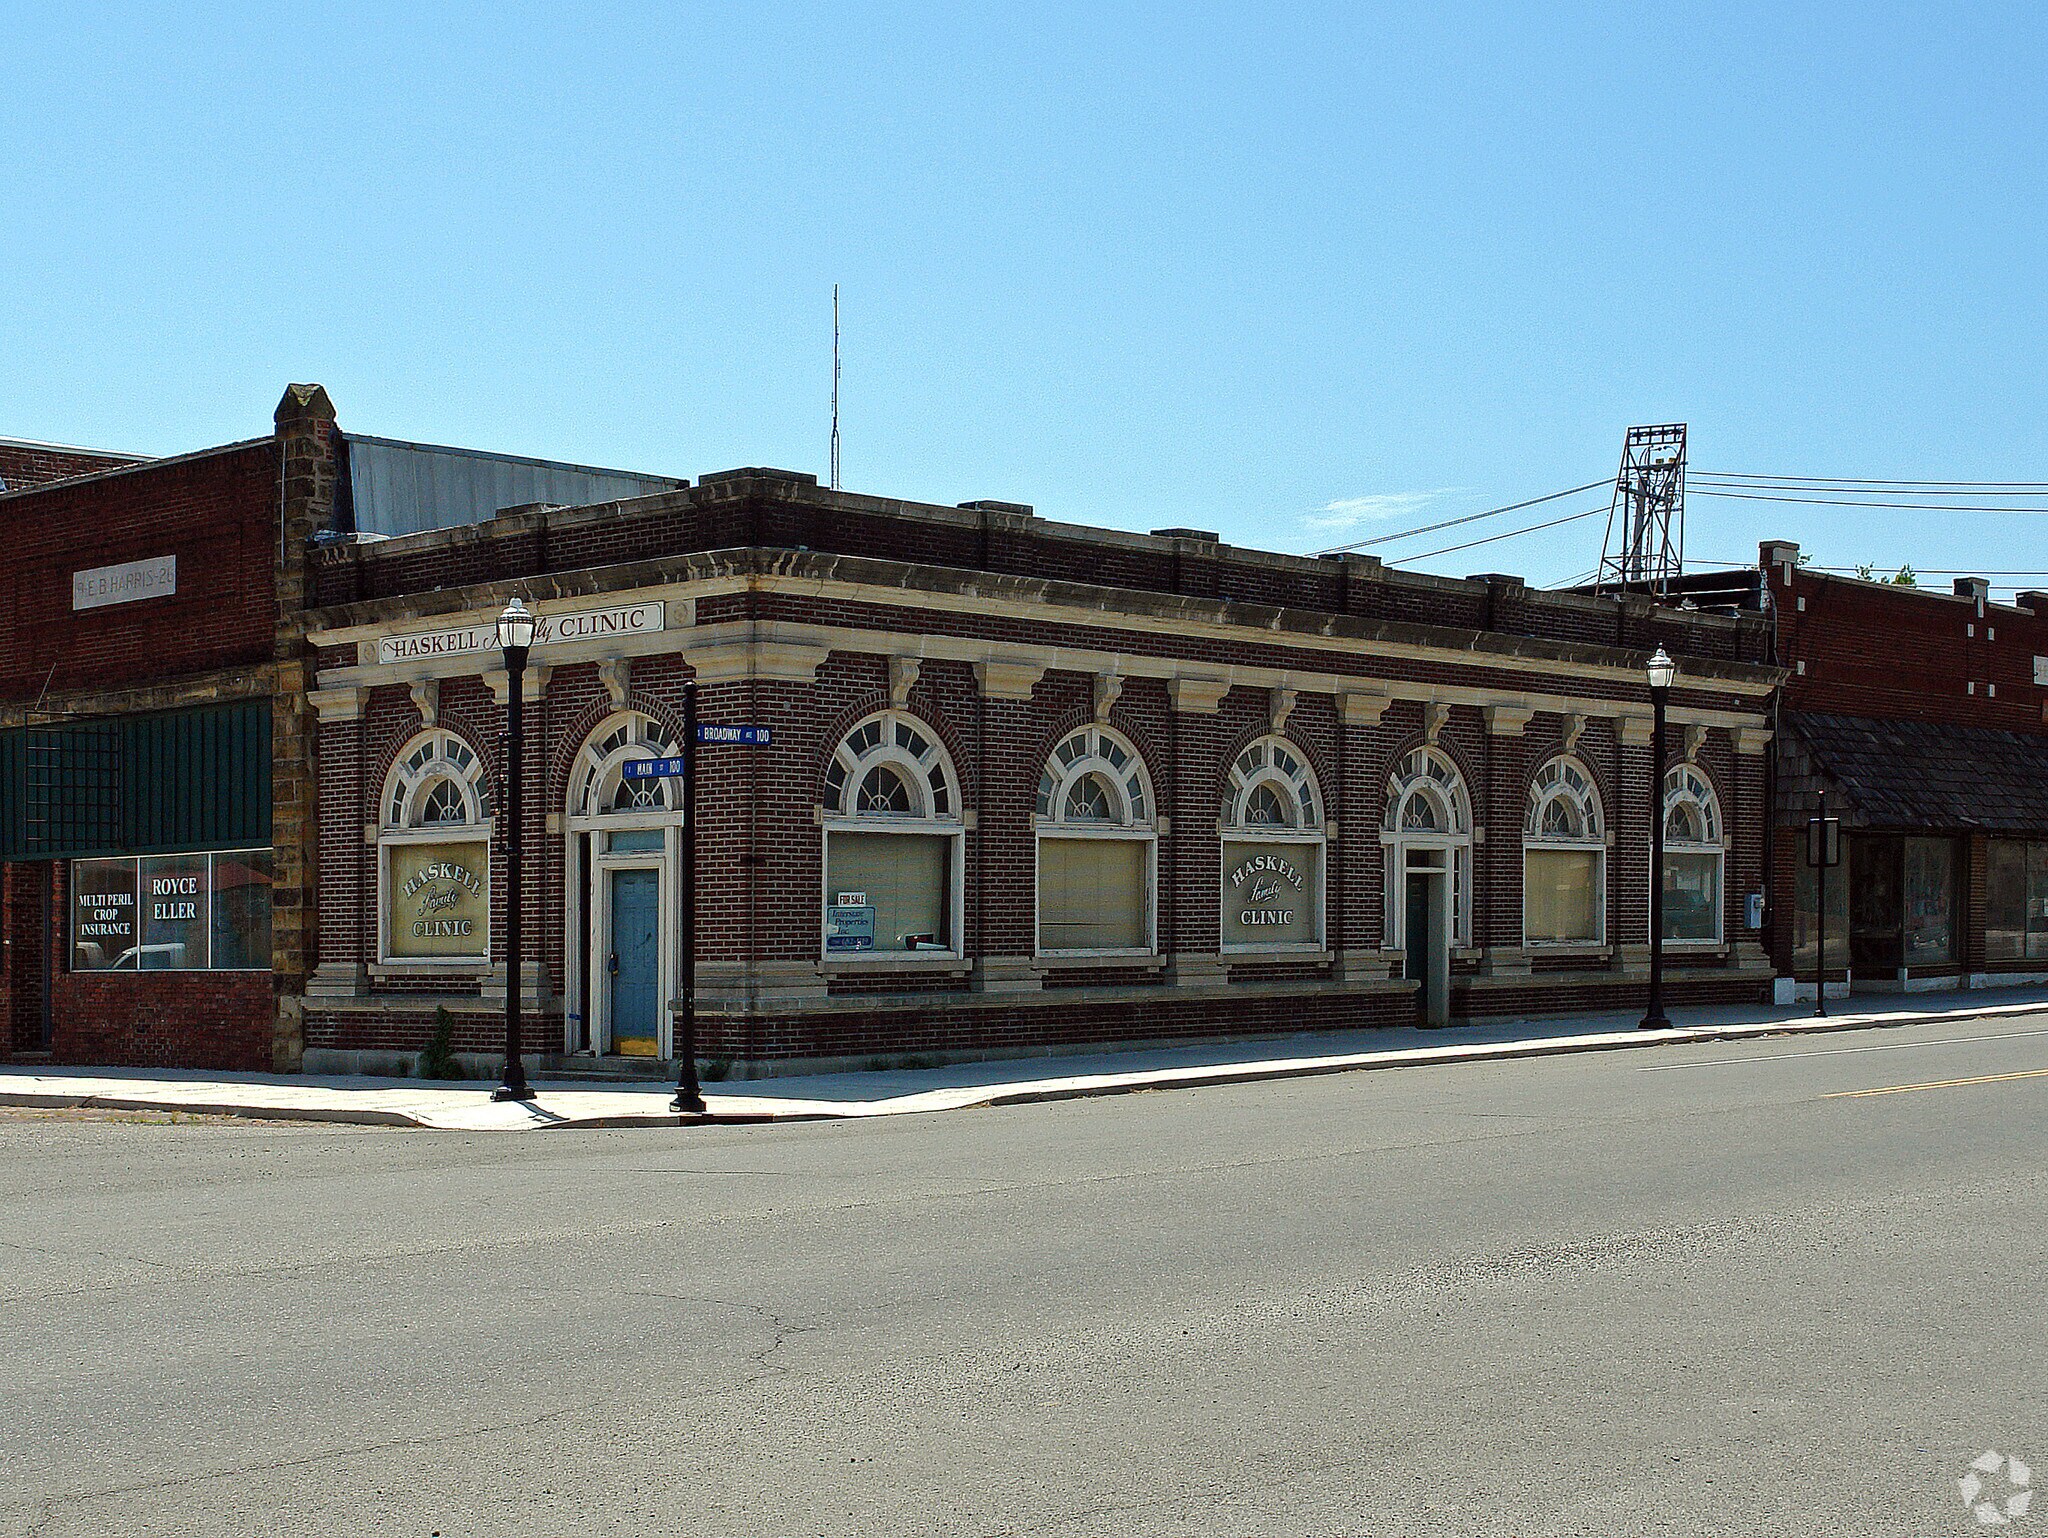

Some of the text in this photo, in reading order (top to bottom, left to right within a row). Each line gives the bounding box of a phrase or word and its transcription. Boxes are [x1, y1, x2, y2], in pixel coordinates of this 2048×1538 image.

[382, 631, 479, 658] HASKELL
[559, 609, 646, 637] CLINIC
[704, 727, 741, 741] BROADWAY
[756, 729, 769, 742] 100
[403, 862, 482, 898] HASKELL
[1231, 855, 1304, 892] HASKELL
[152, 877, 197, 896] ROYCE
[78, 893, 134, 907] MULTI PERIL
[839, 895, 865, 905] FOR SALE
[93, 908, 118, 921] CROP
[153, 902, 196, 920] ELLER
[1240, 910, 1294, 925] CLINIC
[81, 922, 131, 936] INSURANCE
[412, 920, 472, 937] CLINIC
